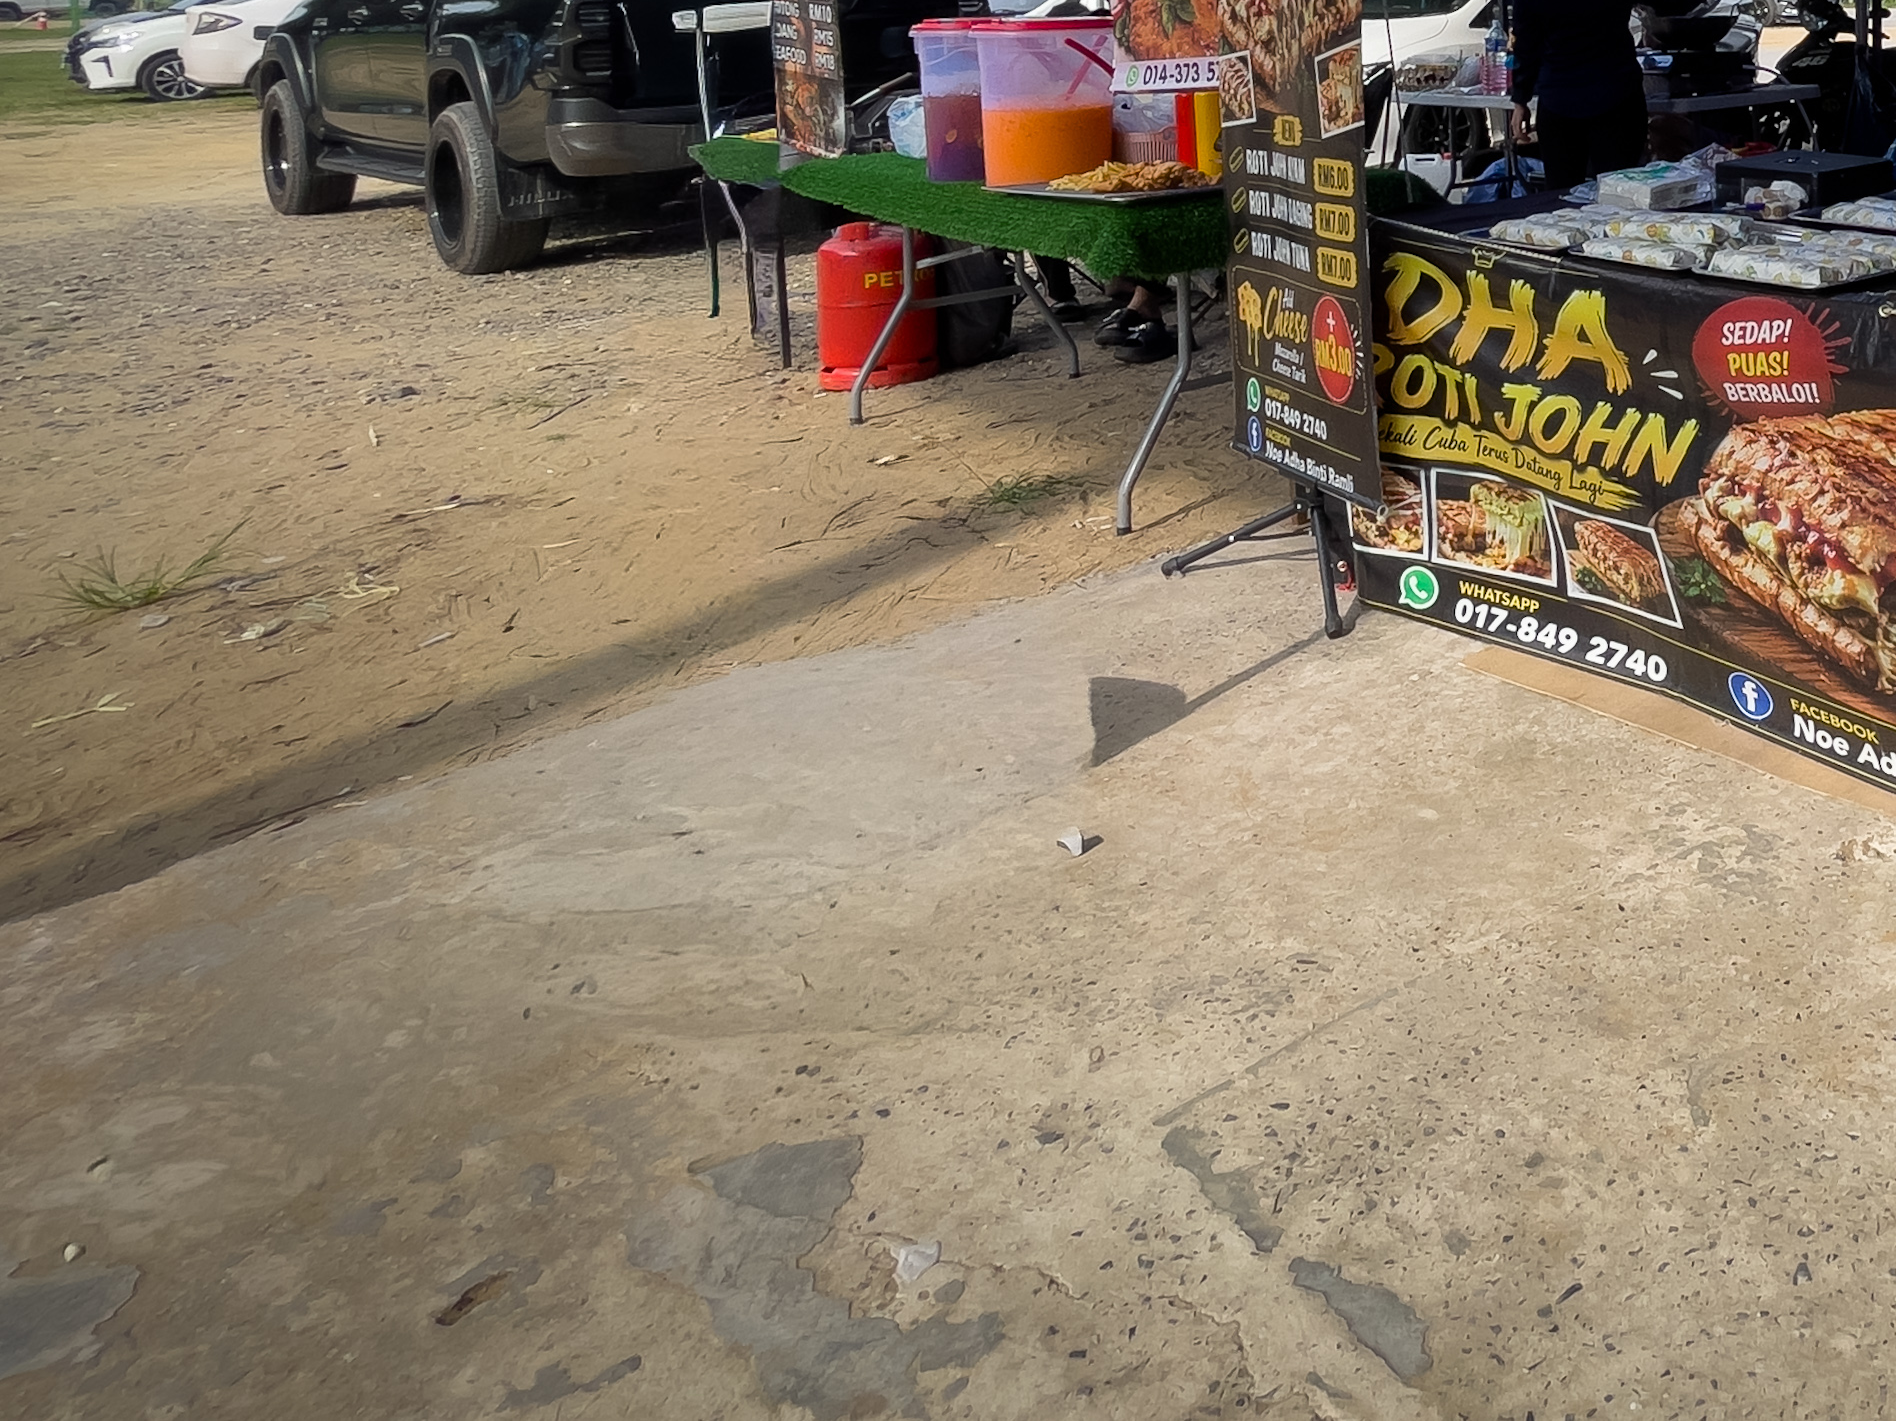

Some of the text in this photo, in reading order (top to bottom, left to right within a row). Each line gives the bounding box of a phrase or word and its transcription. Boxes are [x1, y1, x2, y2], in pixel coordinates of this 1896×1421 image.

[775, 45, 807, 65] EAFOOD
[1143, 62, 1200, 85] 014-373
[1263, 287, 1309, 344] Cheese
[1382, 252, 1632, 395] DHA
[1721, 318, 1793, 347] SEDAP!
[1315, 334, 1353, 377] RM3.00
[1727, 352, 1789, 376] PUAS!
[1723, 382, 1821, 405] BERBALOI!
[1264, 398, 1327, 440] 017-849 2740
[1494, 382, 1699, 487] JOHN
[1379, 423, 1605, 502] ekali Cuba Terus Datang Lagi
[1459, 580, 1540, 614] WHATSAPP
[1454, 600, 1668, 682] 017-849 2740
[1789, 697, 1880, 744] FACEBOOK
[1792, 713, 1850, 759] Noe
